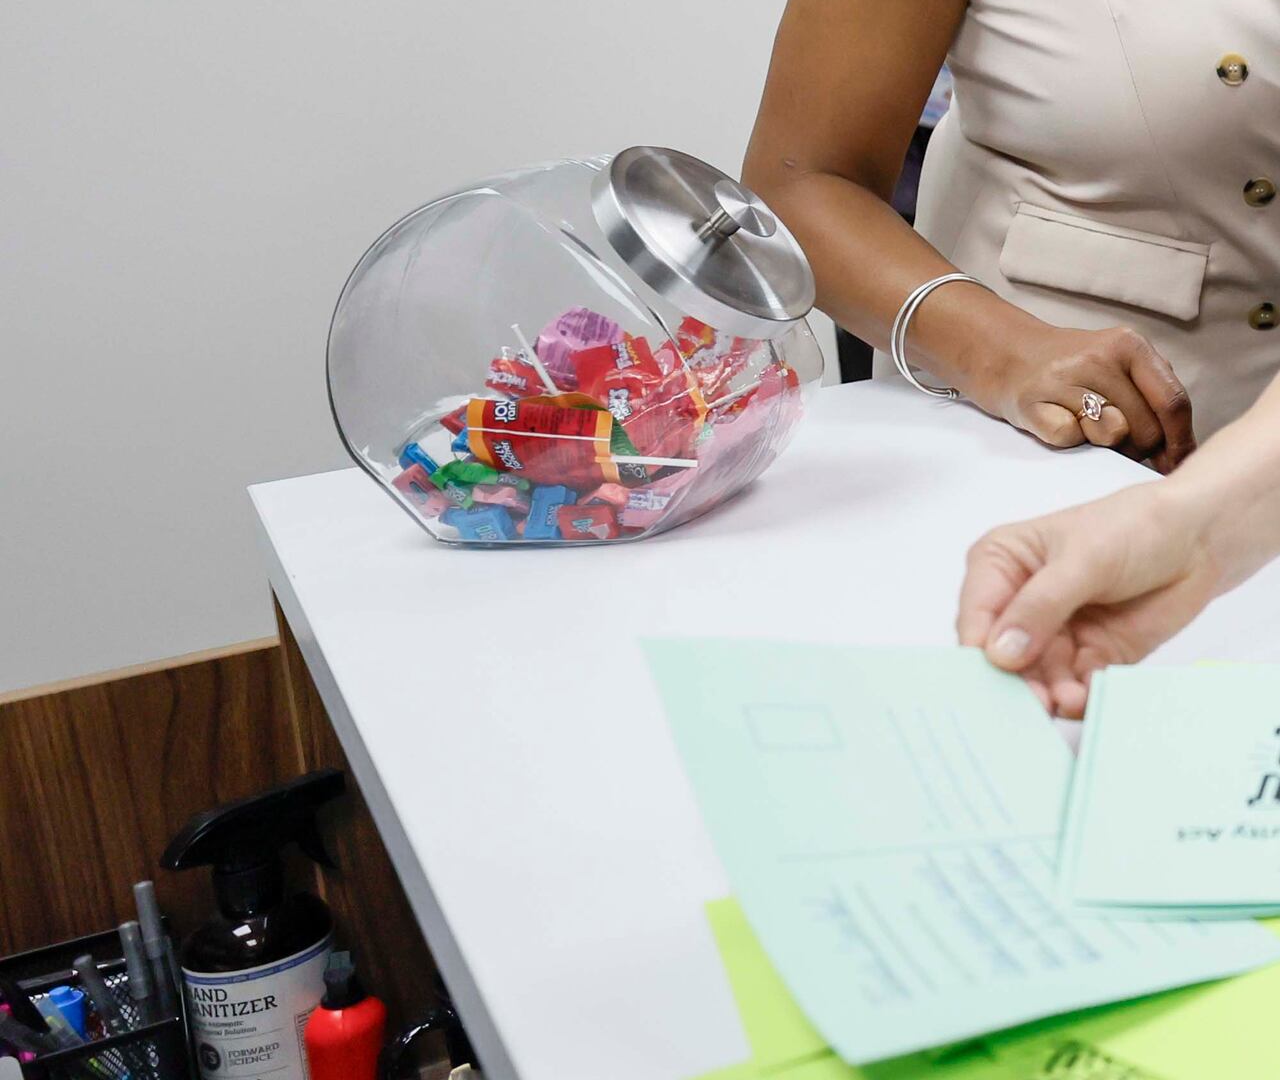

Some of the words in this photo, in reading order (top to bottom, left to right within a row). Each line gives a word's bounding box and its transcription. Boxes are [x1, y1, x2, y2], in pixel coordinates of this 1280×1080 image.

[1176, 825, 1223, 843] Act
[190, 987, 227, 1003] AND
[191, 995, 279, 1018] ANITIZER
[228, 1042, 280, 1059] FORWARD
[228, 1052, 274, 1067] SCIENCE
